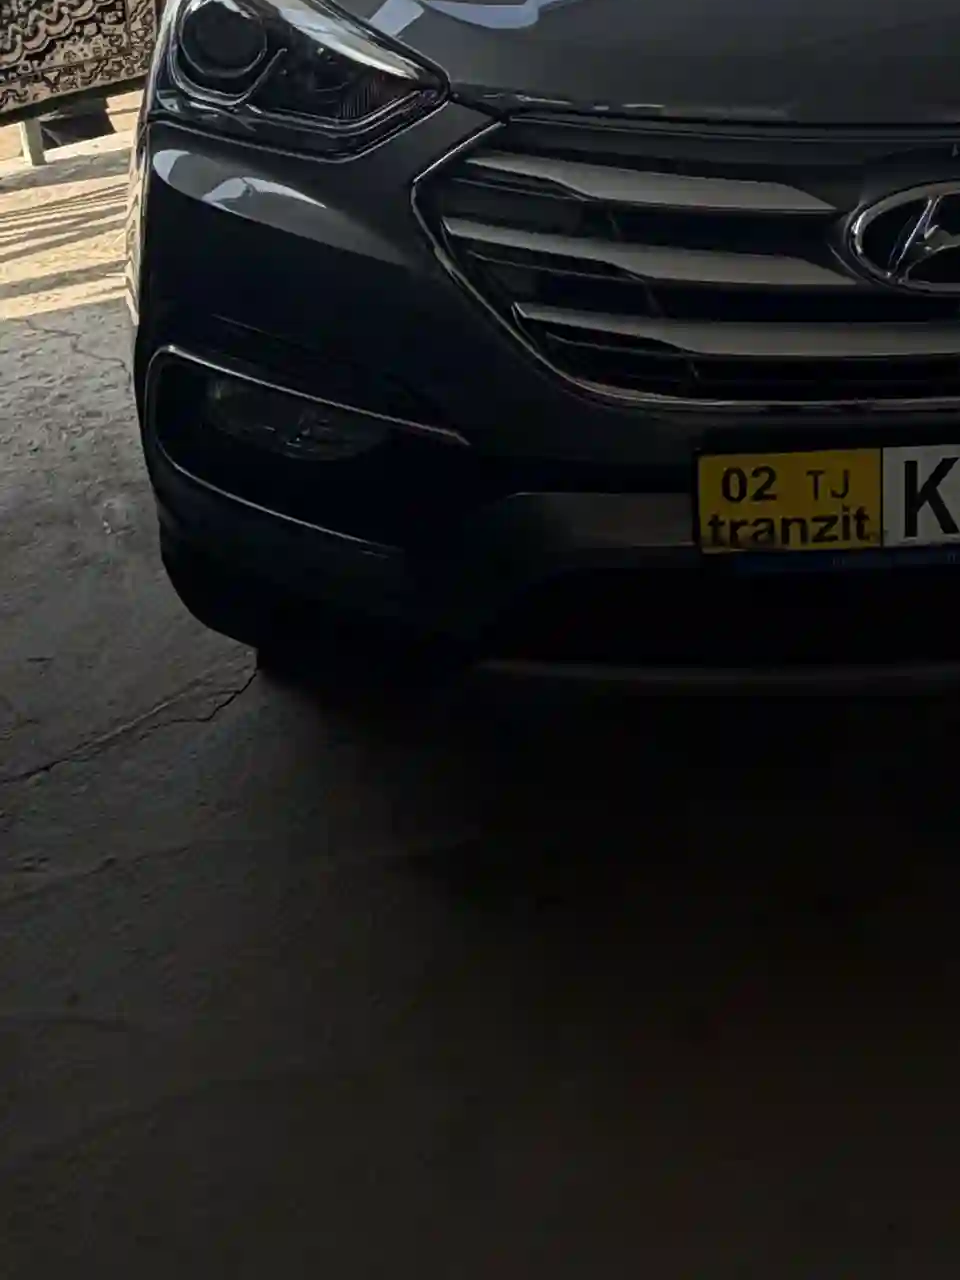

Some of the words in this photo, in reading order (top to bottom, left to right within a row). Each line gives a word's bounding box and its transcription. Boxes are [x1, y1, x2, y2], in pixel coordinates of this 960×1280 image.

[720, 465, 777, 503] 02
[806, 468, 850, 499] TJ
[707, 506, 870, 548] tranzit
